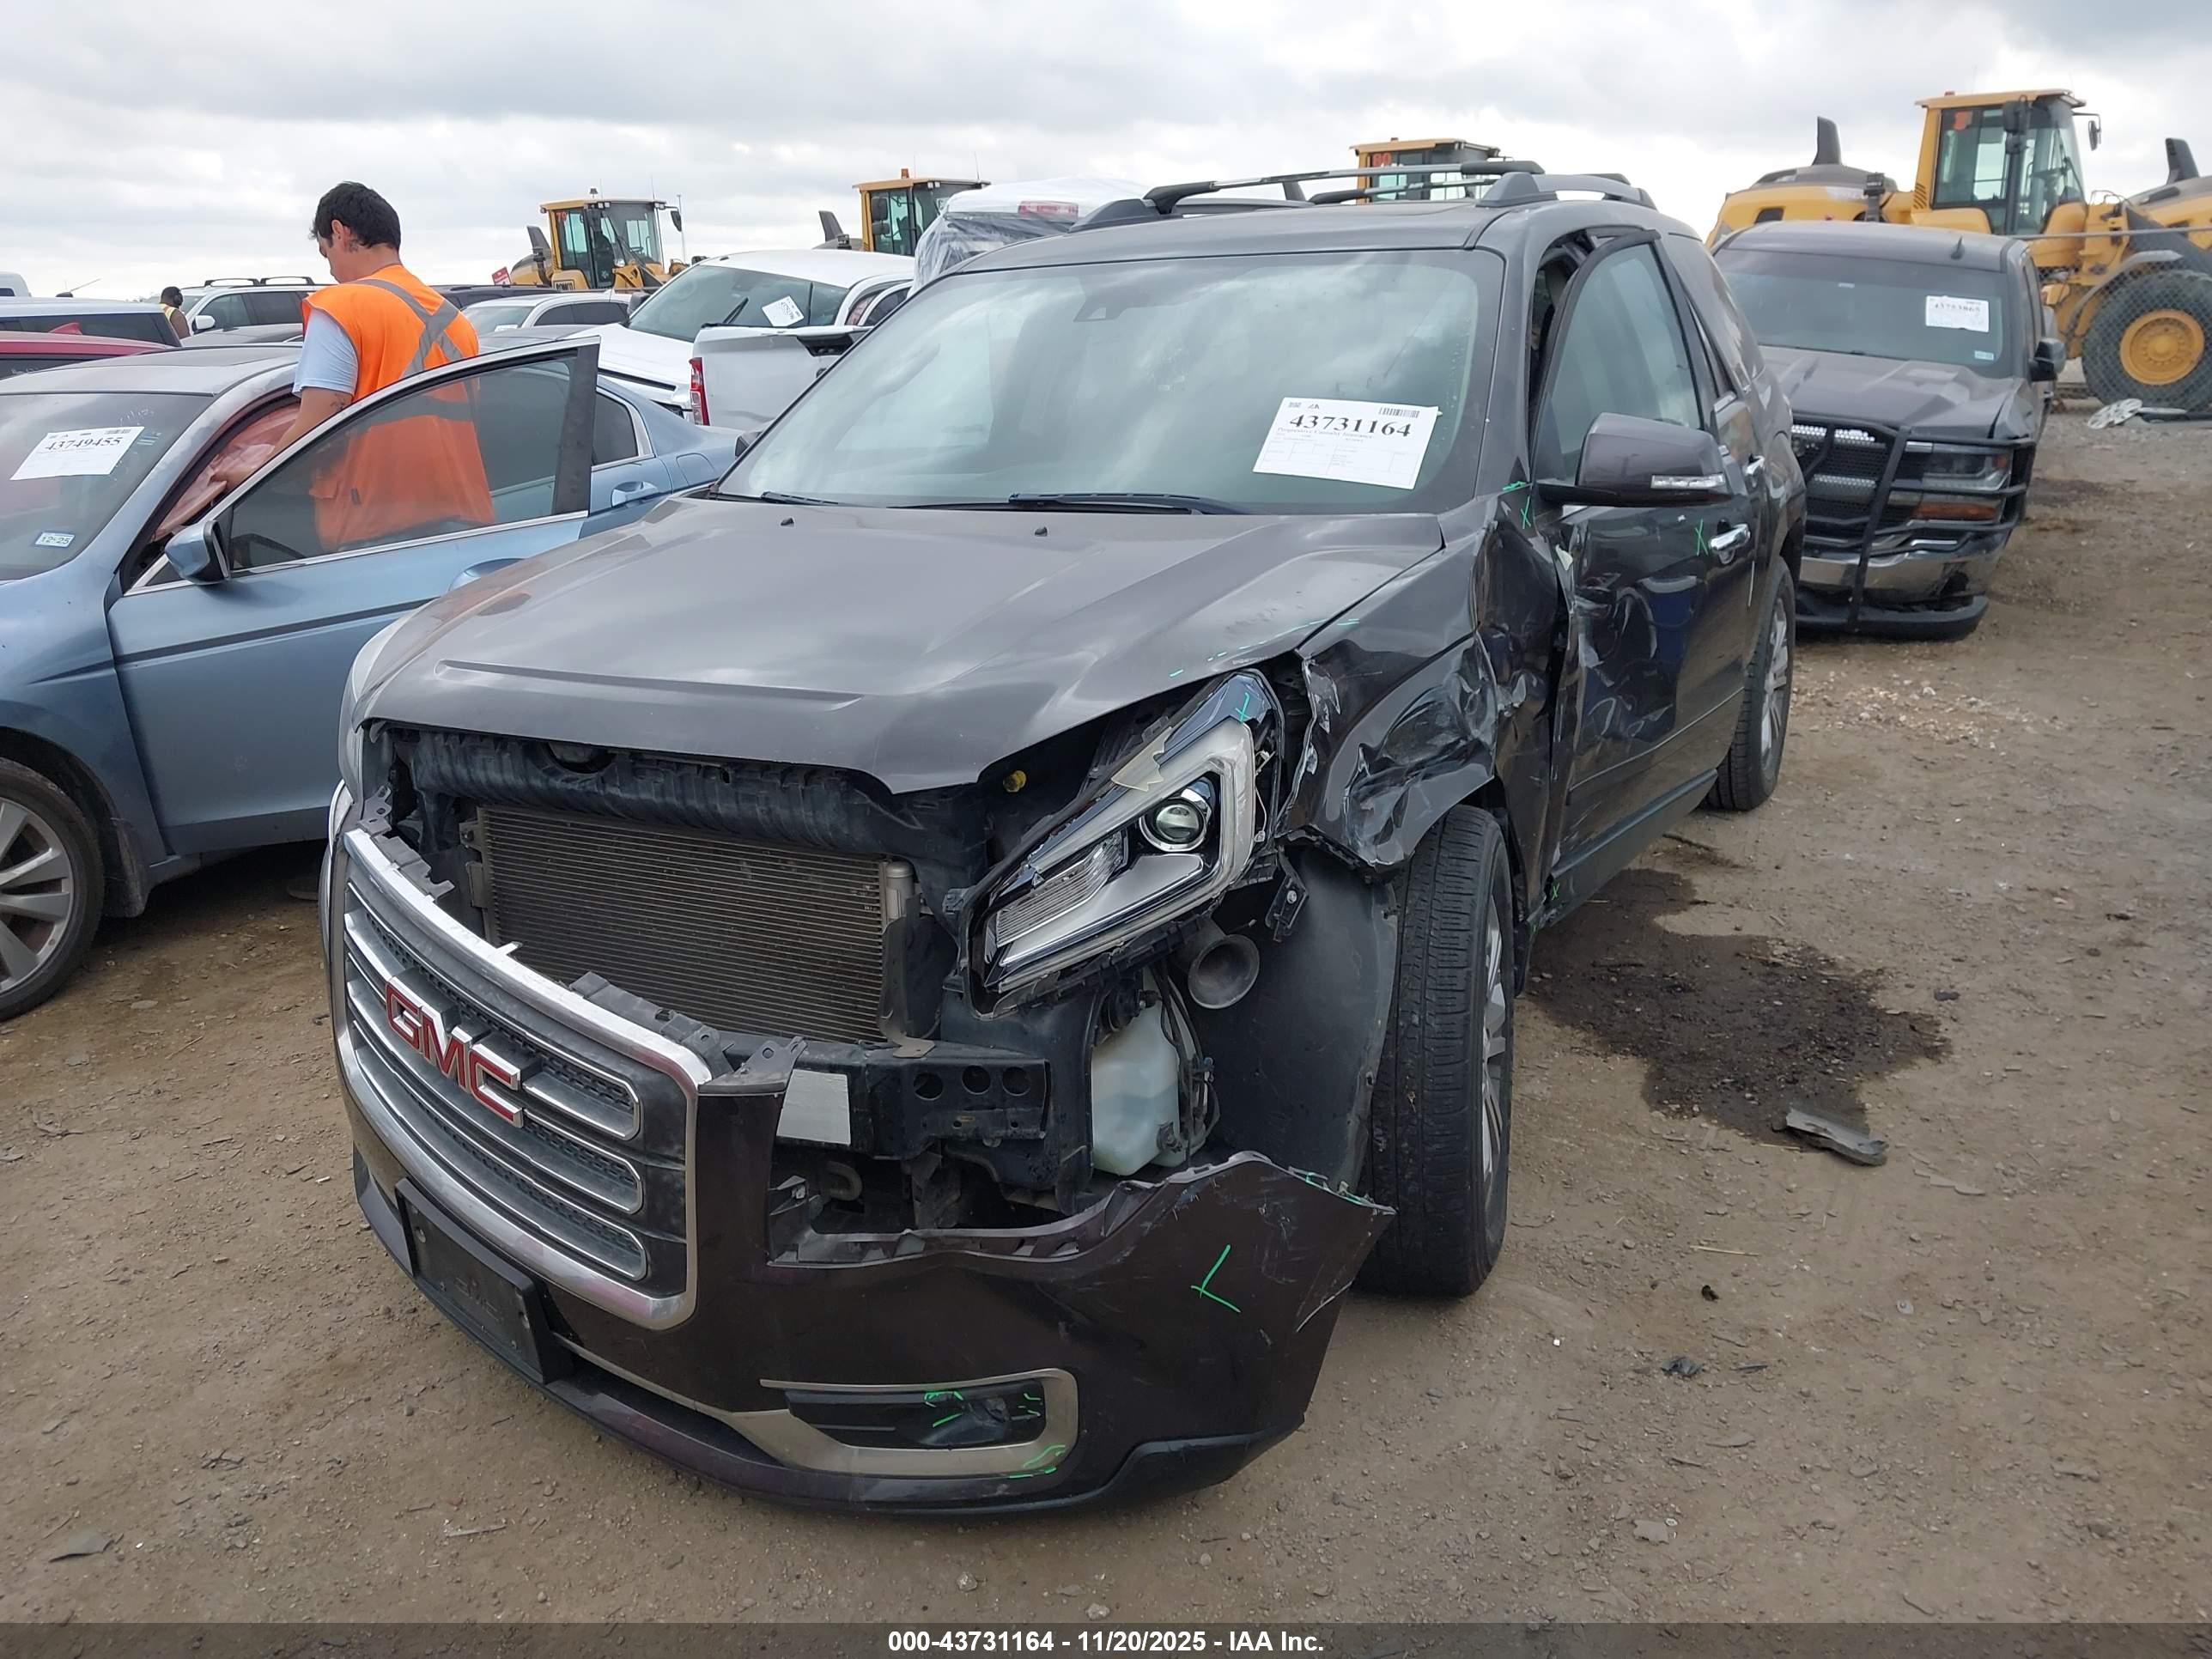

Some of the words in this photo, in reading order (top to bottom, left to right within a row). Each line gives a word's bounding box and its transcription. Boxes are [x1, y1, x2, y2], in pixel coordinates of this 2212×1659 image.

[1290, 414, 1411, 437] 43731164
[46, 436, 123, 451] 43749455
[386, 976, 523, 1128] GMC
